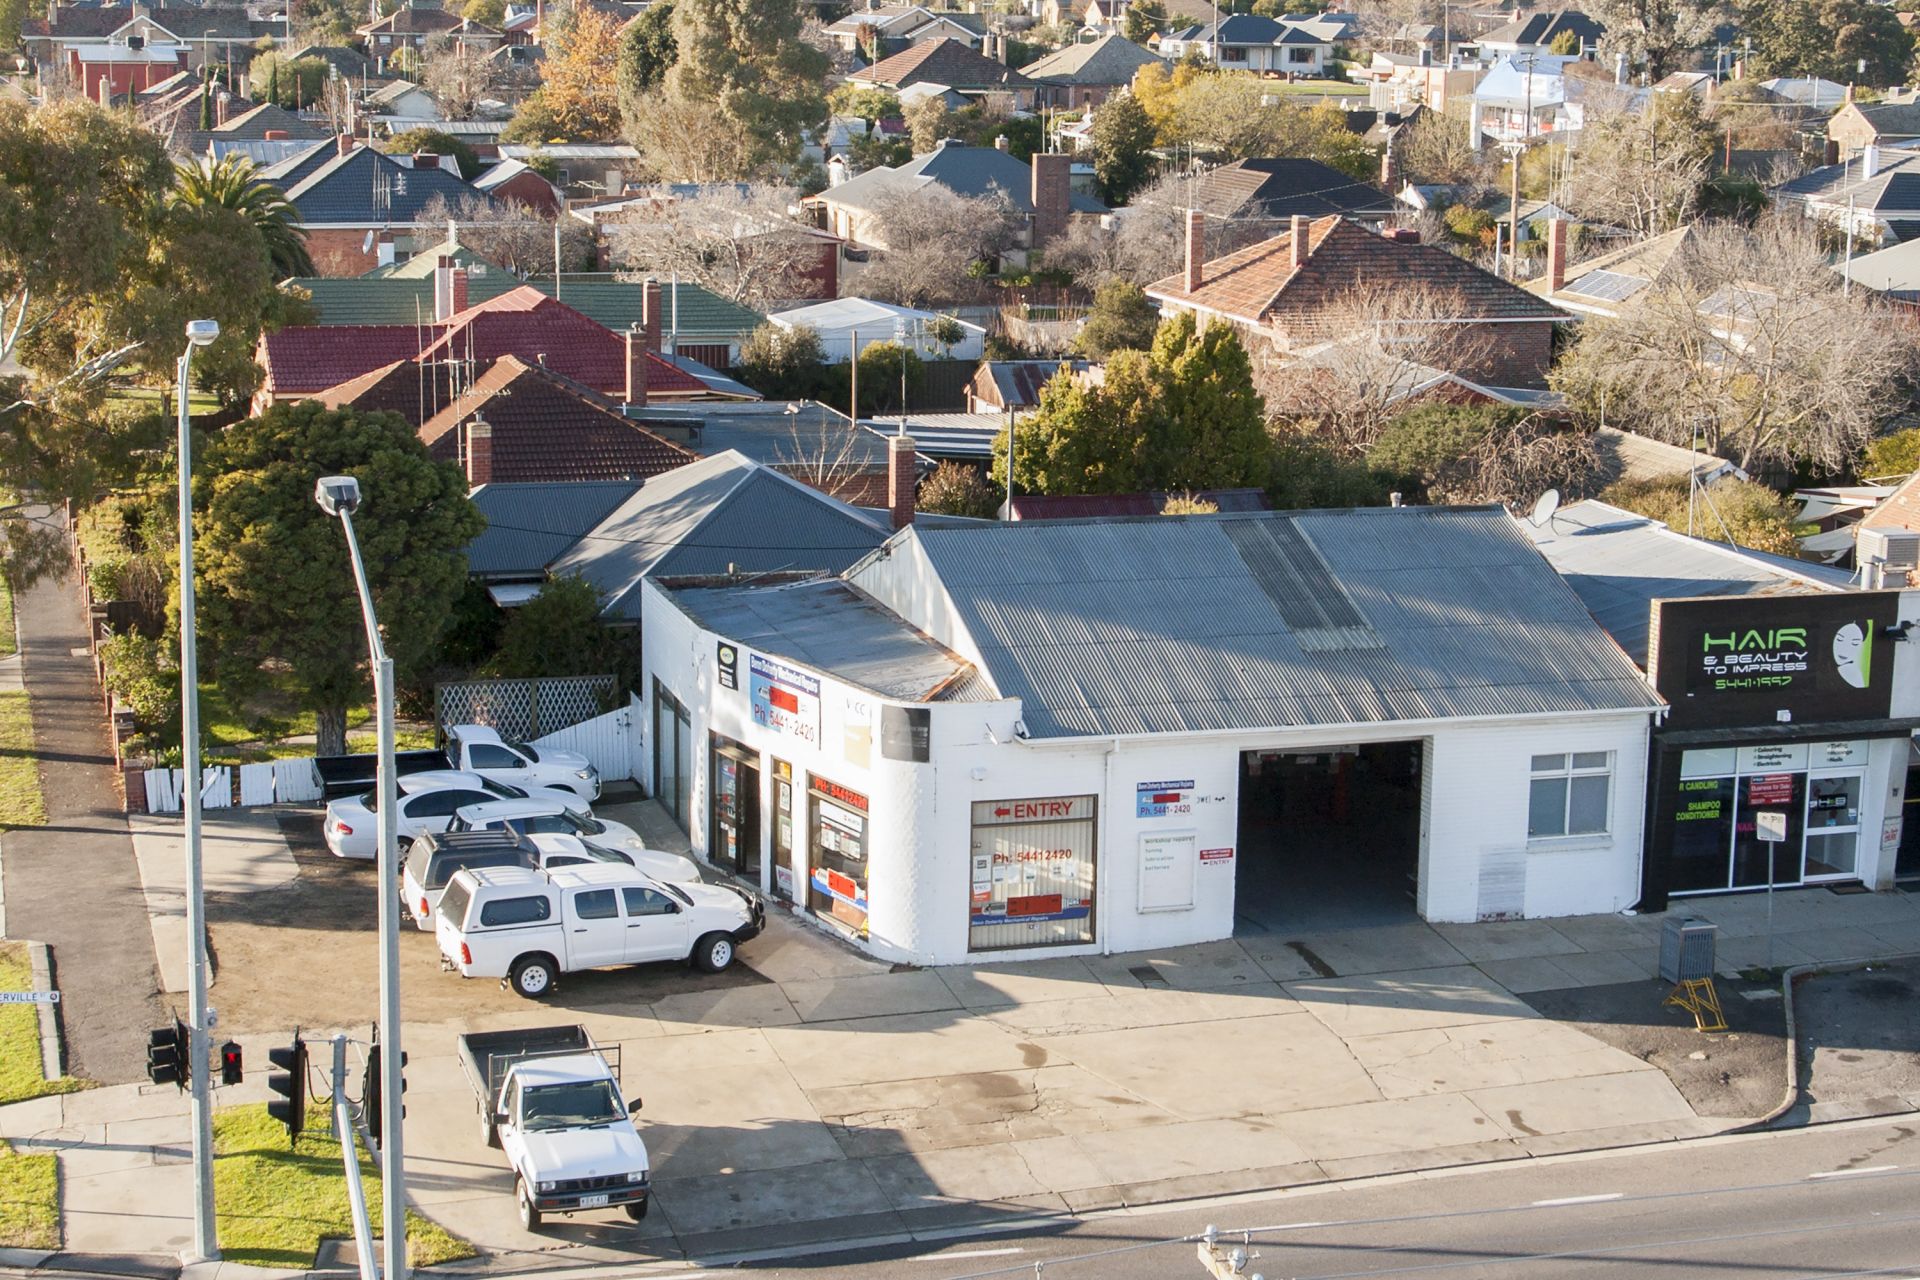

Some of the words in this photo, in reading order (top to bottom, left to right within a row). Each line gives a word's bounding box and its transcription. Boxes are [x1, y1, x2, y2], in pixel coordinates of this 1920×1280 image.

[1703, 628, 1807, 652] HAIR
[1704, 656, 1718, 665] &
[1724, 652, 1808, 664] BEAUTY
[1703, 666, 1727, 675] TO
[1733, 662, 1808, 673] IMPRESS
[1686, 781, 1718, 791] CANDLING
[1014, 801, 1073, 818] ENTRY
[1688, 800, 1720, 810] SHAMPOO
[1676, 811, 1720, 821] CONDITIONER
[993, 853, 1012, 864] Ph:
[1017, 849, 1072, 862] 54412420
